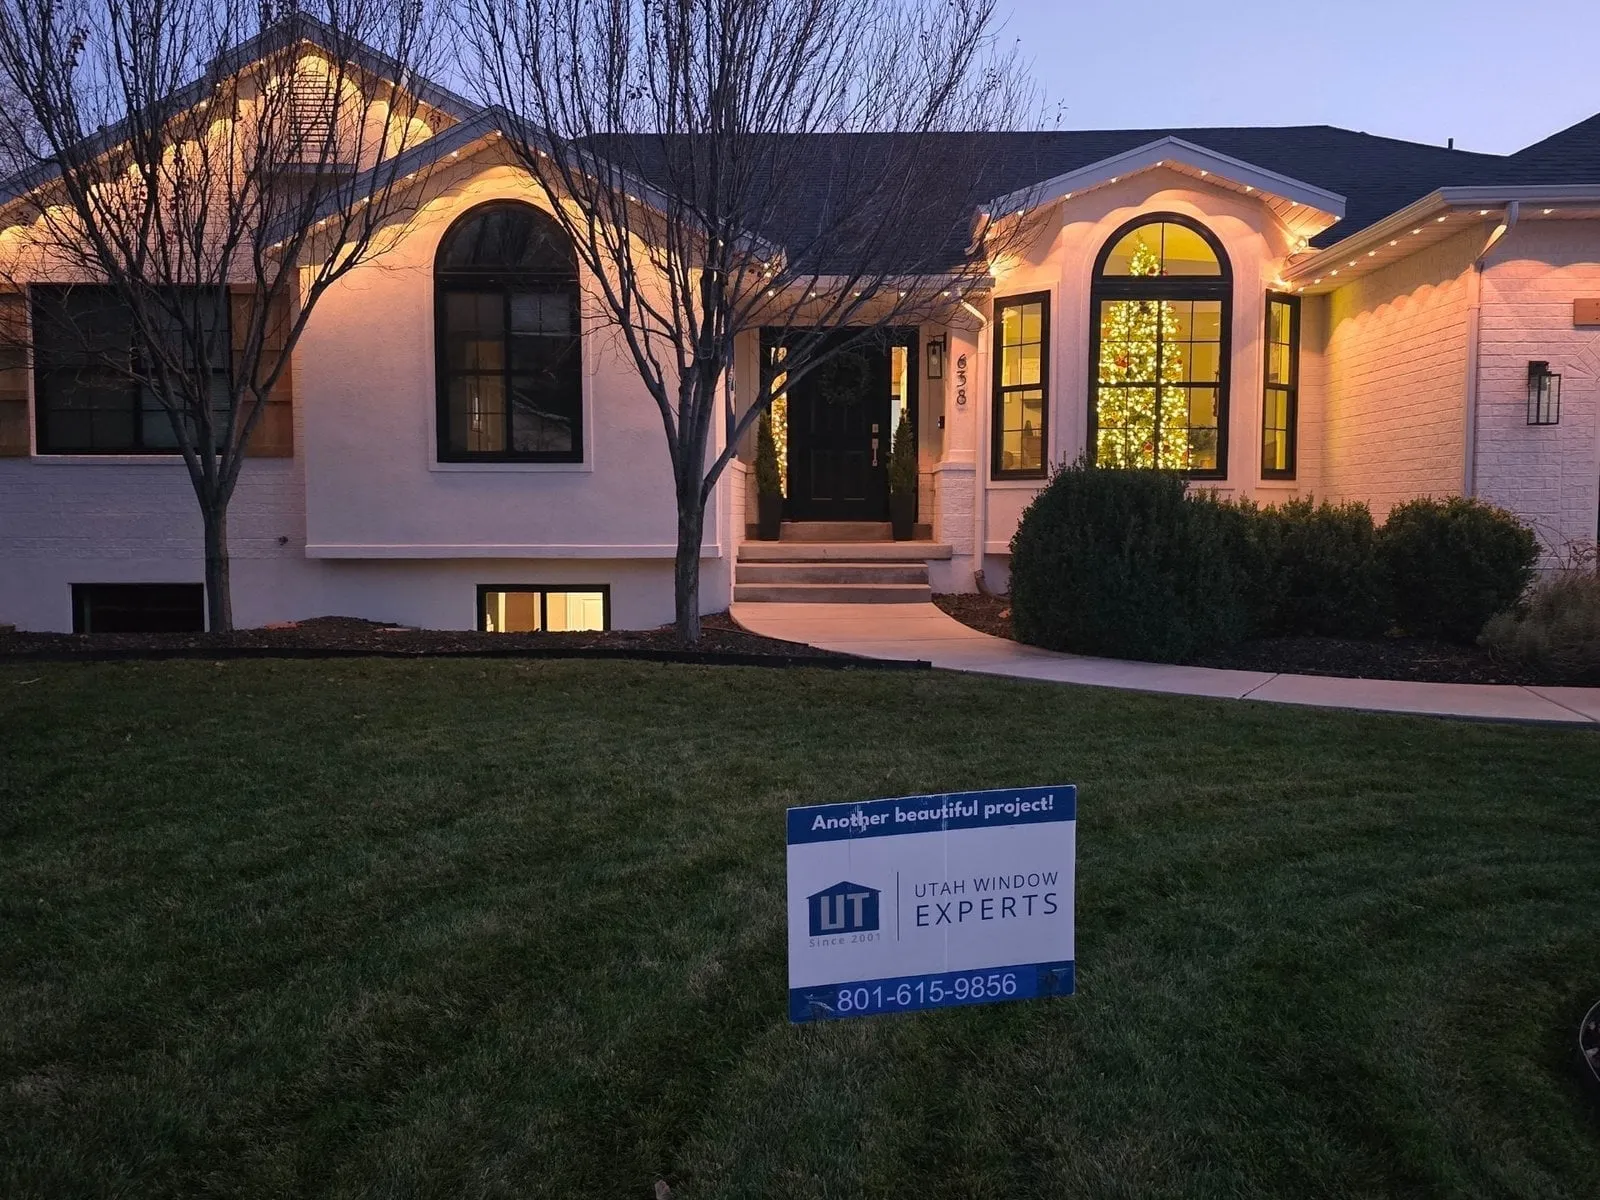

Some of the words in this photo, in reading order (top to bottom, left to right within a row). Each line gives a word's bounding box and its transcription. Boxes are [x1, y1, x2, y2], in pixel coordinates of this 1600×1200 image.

[956, 353, 967, 406] 638
[811, 810, 889, 831] Another
[895, 799, 978, 823] beautiful
[984, 794, 1054, 819] project!
[914, 879, 965, 898] UTAH
[973, 871, 1058, 892] WINDOW
[820, 892, 870, 930] UT
[916, 892, 1058, 927] EXPERTS
[809, 936, 846, 948] Since
[851, 932, 881, 944] 2001
[837, 973, 1017, 1012] 801-615-9856
